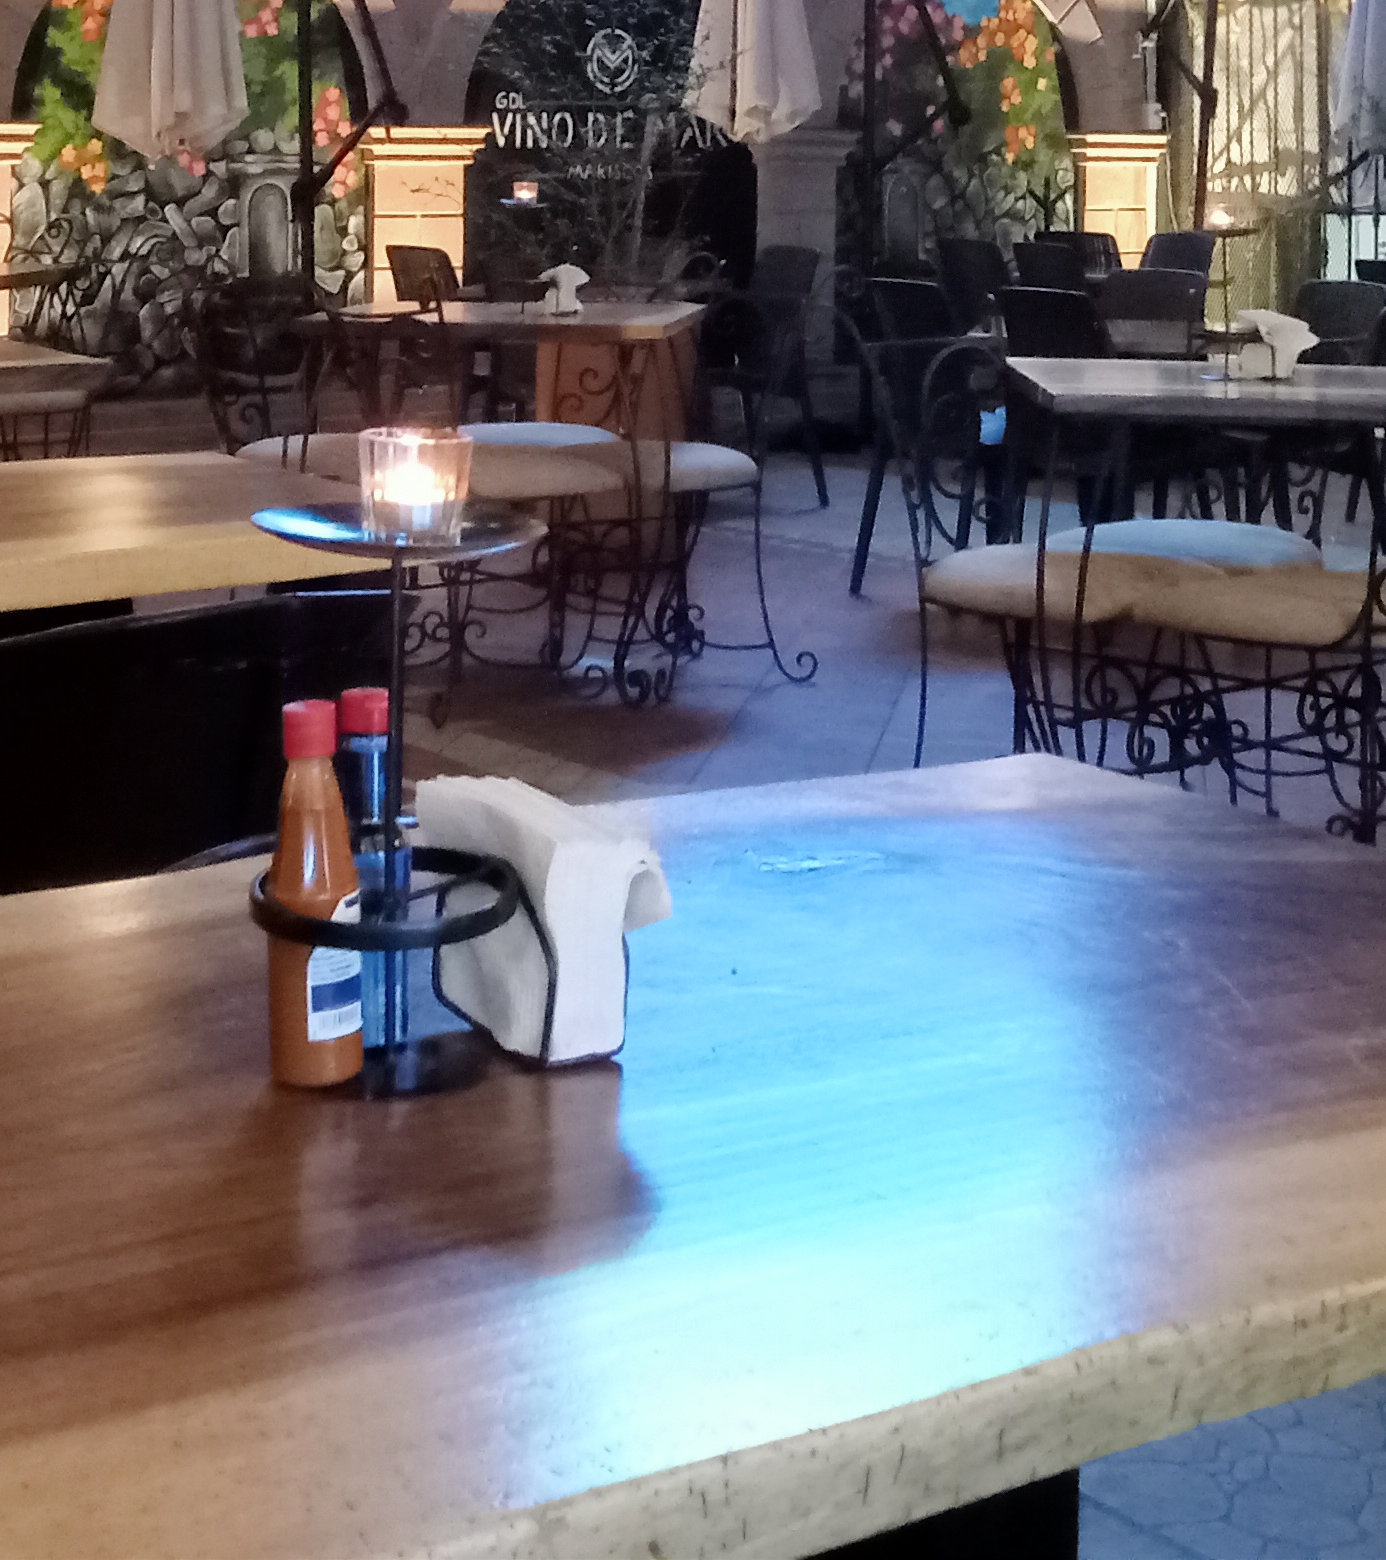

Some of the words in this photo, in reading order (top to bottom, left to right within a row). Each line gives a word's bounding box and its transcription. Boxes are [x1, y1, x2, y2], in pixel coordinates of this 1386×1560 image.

[495, 91, 527, 110] GDL
[491, 111, 574, 149] VINO
[587, 111, 635, 149] DE
